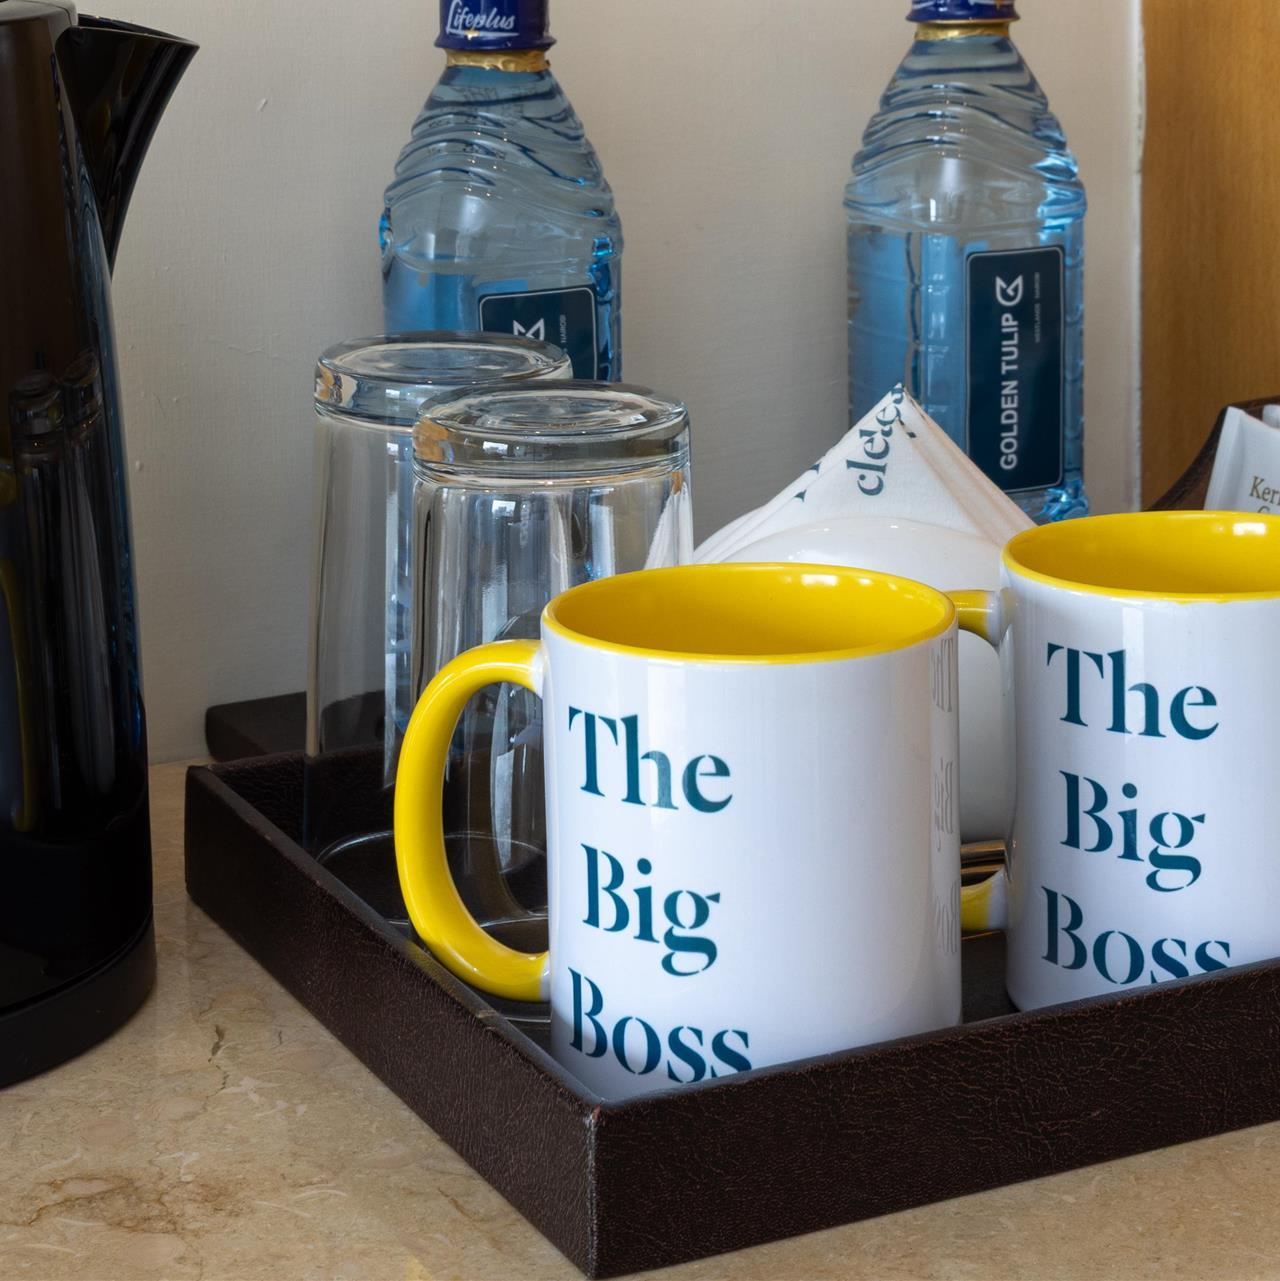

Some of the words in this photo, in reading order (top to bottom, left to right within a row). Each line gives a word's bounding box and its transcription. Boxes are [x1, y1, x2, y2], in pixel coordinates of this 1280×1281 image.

[1001, 313, 1019, 375] TULIP
[1000, 380, 1018, 471] GOLDEN
[1047, 642, 1220, 741] The
[568, 705, 733, 813] The
[1059, 770, 1206, 893] Big
[581, 842, 721, 977] Big
[1041, 886, 1230, 985] Boss
[567, 966, 752, 1084] Boss
